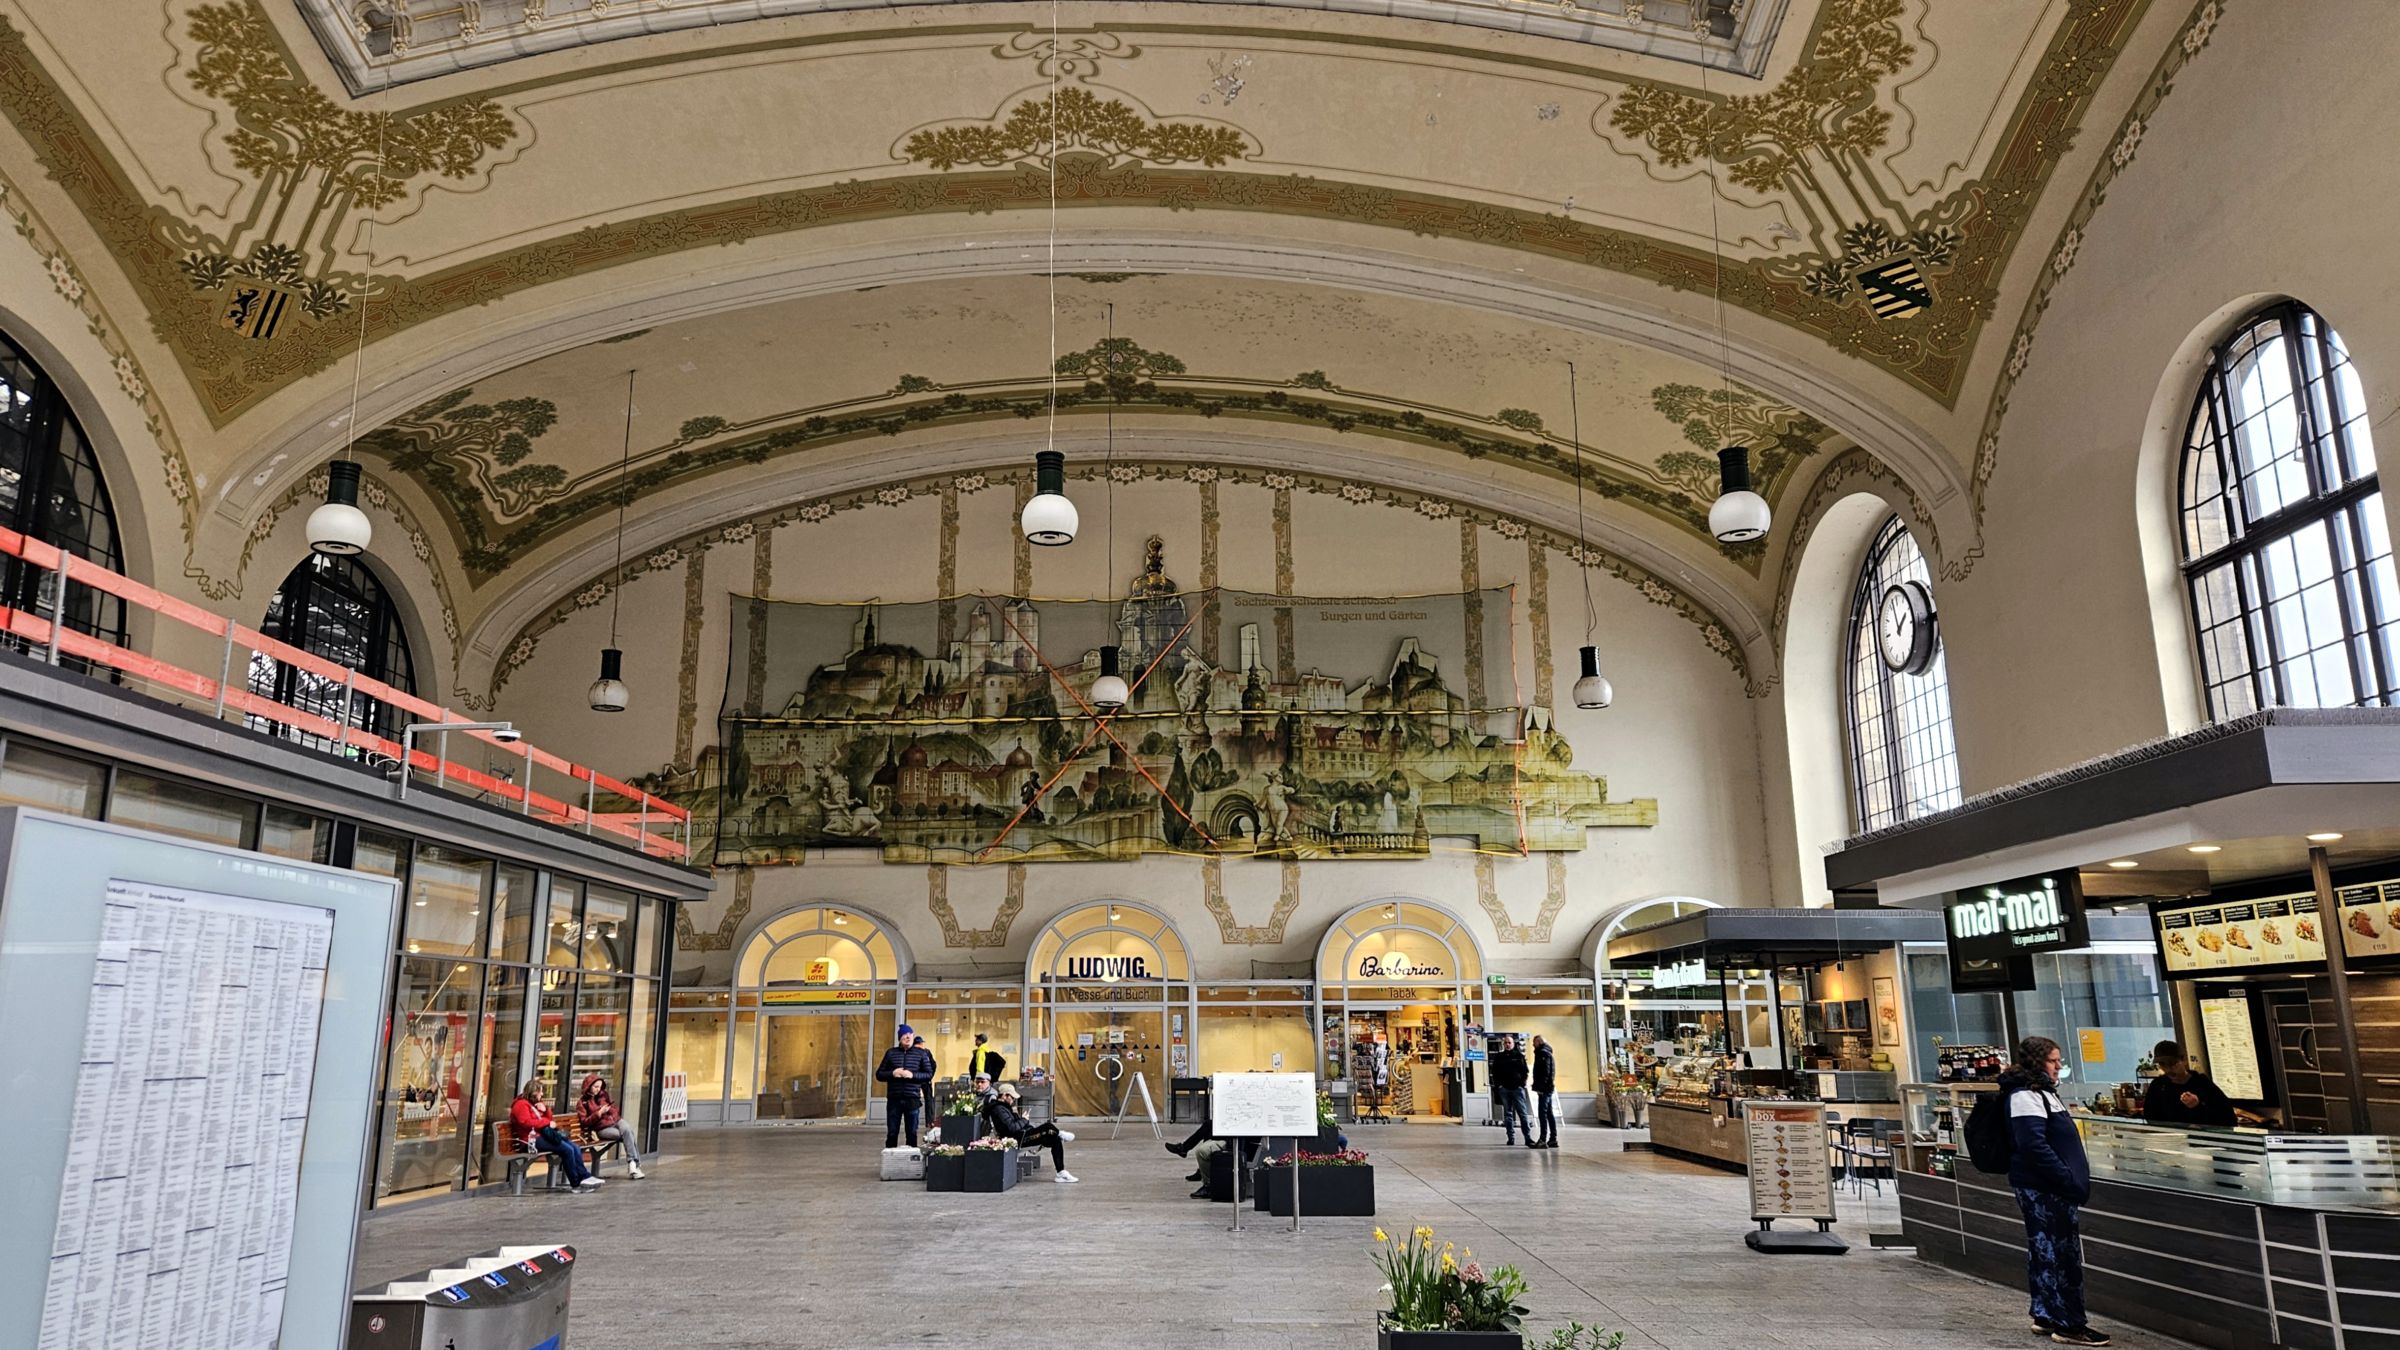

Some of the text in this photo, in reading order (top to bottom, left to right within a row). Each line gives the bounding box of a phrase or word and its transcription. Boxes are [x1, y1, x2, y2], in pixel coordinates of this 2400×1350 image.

[1320, 611, 1428, 623] Burgen und Gärten
[1068, 988, 1150, 1000] Presse und Buch
[1388, 987, 1417, 999] Tabak
[1755, 1110, 1775, 1121] box
